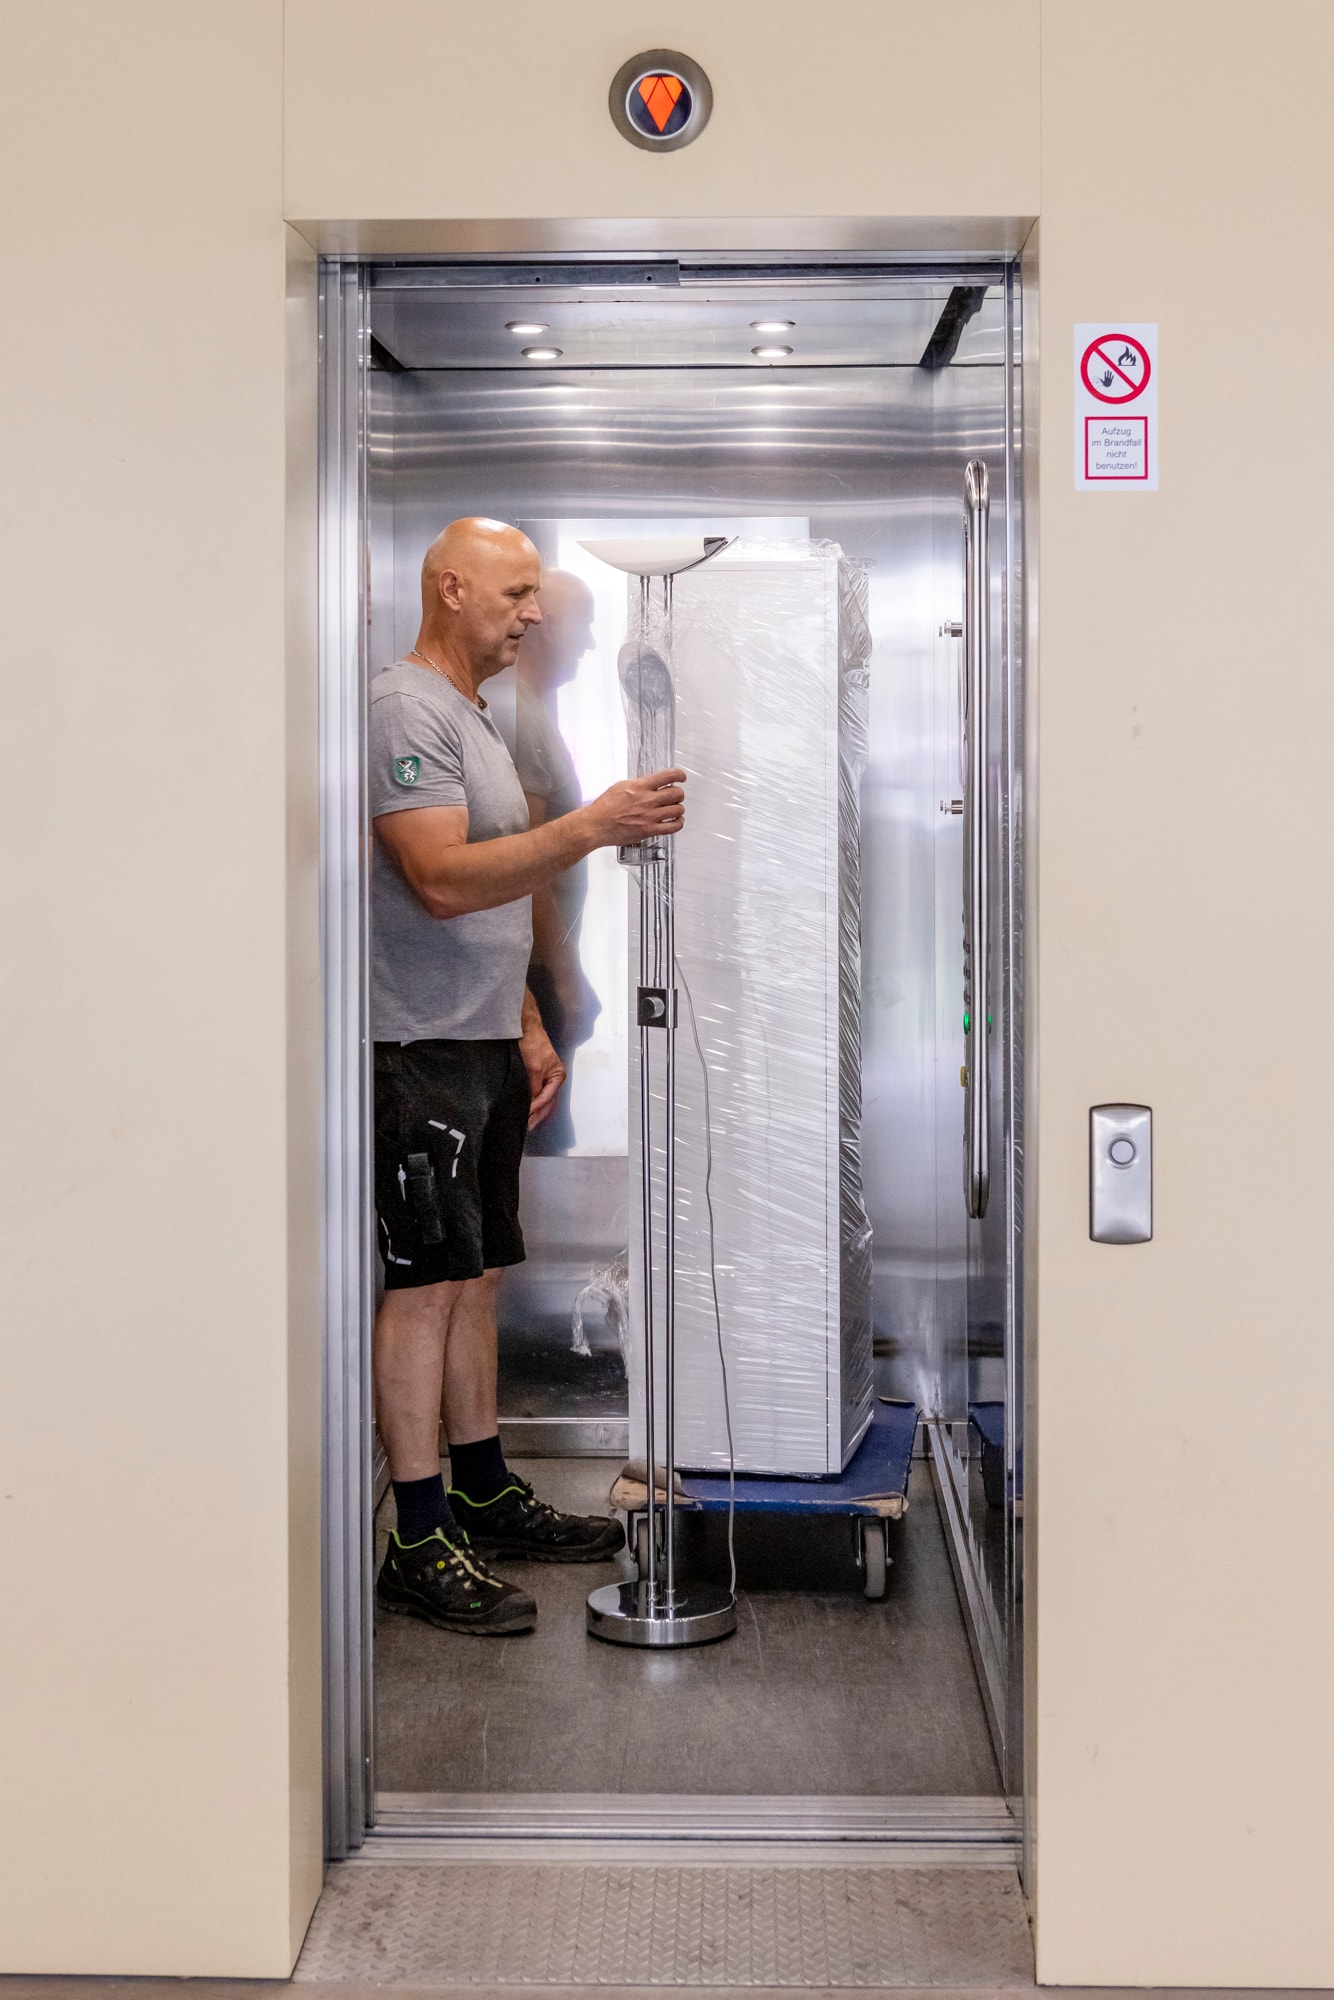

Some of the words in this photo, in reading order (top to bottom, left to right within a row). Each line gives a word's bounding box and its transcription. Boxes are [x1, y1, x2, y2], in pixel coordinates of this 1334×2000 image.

[1101, 427, 1132, 437] Aufzug
[1091, 439, 1102, 447] im
[1104, 438, 1142, 447] Brandfall
[1106, 450, 1127, 458] nicht
[1095, 462, 1138, 470] benutzen!
